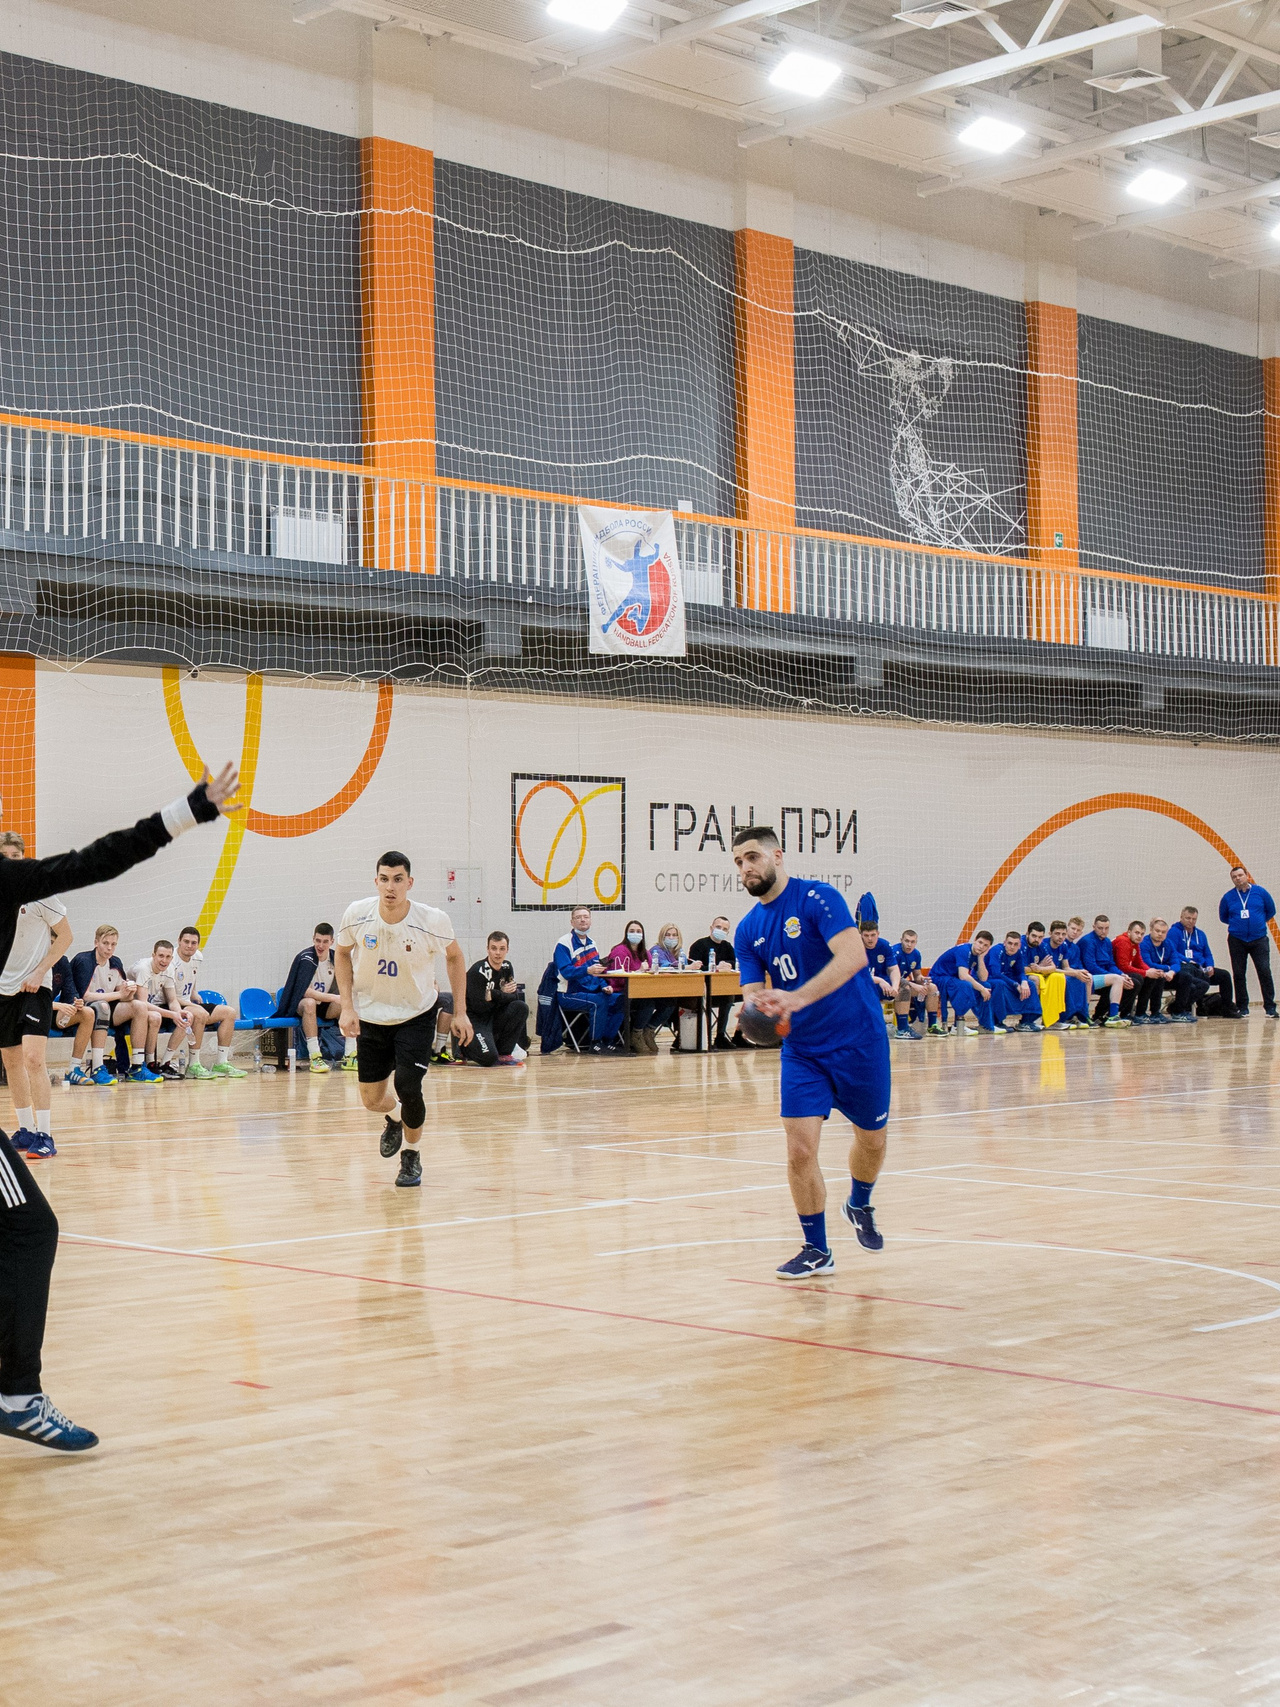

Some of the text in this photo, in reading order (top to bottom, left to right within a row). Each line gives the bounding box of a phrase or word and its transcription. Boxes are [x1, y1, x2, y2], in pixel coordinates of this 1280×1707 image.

[613, 628, 647, 648] HANDBALL
[648, 604, 677, 646] FEDERATION
[650, 802, 858, 853] ГРАНПРИ
[655, 873, 745, 892] СПОРТИВ
[377, 959, 398, 977] 20
[773, 953, 798, 981] 10
[182, 983, 193, 996] 27
[314, 982, 325, 993] 25
